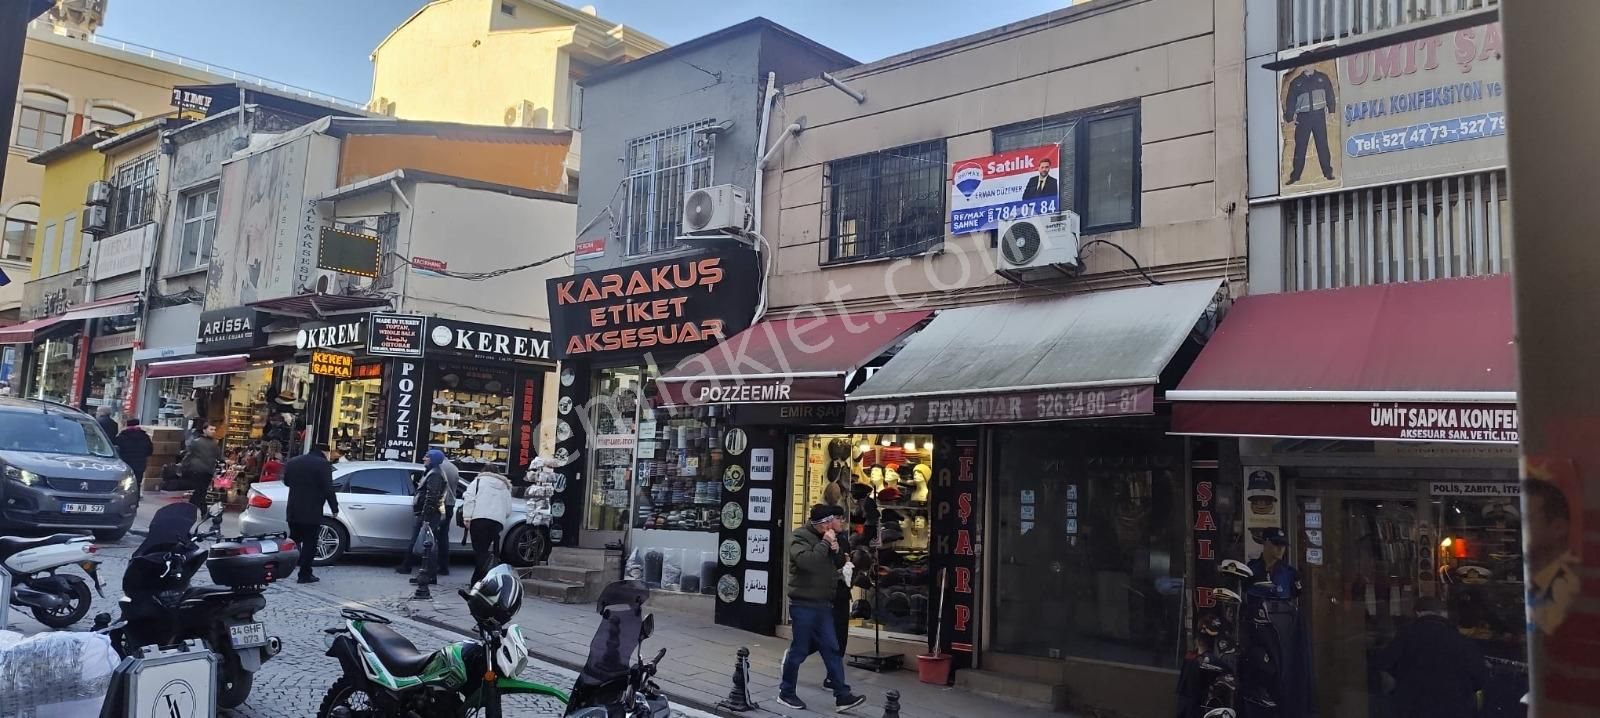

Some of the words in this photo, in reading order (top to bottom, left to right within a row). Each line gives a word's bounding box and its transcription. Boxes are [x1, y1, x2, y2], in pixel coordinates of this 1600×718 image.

[1344, 97, 1387, 127] ŞAPKA
[1390, 80, 1483, 115] KONFEKSİYON
[1355, 139, 1380, 151] Tel:
[1383, 131, 1405, 147] 527
[1410, 129, 1425, 143] 47
[1431, 125, 1448, 140] 73
[1460, 119, 1485, 135] 527
[986, 154, 1035, 175] Satılık
[953, 210, 984, 222] RE/MAX
[995, 205, 1018, 220] 784
[1021, 202, 1036, 217] 07
[1040, 199, 1056, 214] 84
[953, 219, 979, 230] SAHNE
[557, 257, 724, 306] KARAKUŞ
[590, 296, 688, 328] ETİKET
[307, 322, 360, 349] KEREM
[455, 328, 551, 359] KEREM
[565, 319, 726, 355] AKSESUAR
[314, 352, 352, 366] KEREM
[397, 362, 414, 438] POZZE
[700, 381, 791, 401] POZZEEMİR
[853, 402, 915, 426] MDF
[926, 396, 1022, 423] FERMUAR
[1370, 402, 1407, 427] ÜMİT
[1409, 408, 1457, 428] ŞAPKA
[1400, 429, 1446, 439] AKSESUAR
[1448, 430, 1470, 440] SAN.
[1433, 484, 1462, 495] POLİS,
[954, 456, 974, 631] EŞARP
[231, 627, 243, 636] 34
[244, 634, 259, 644] 073
